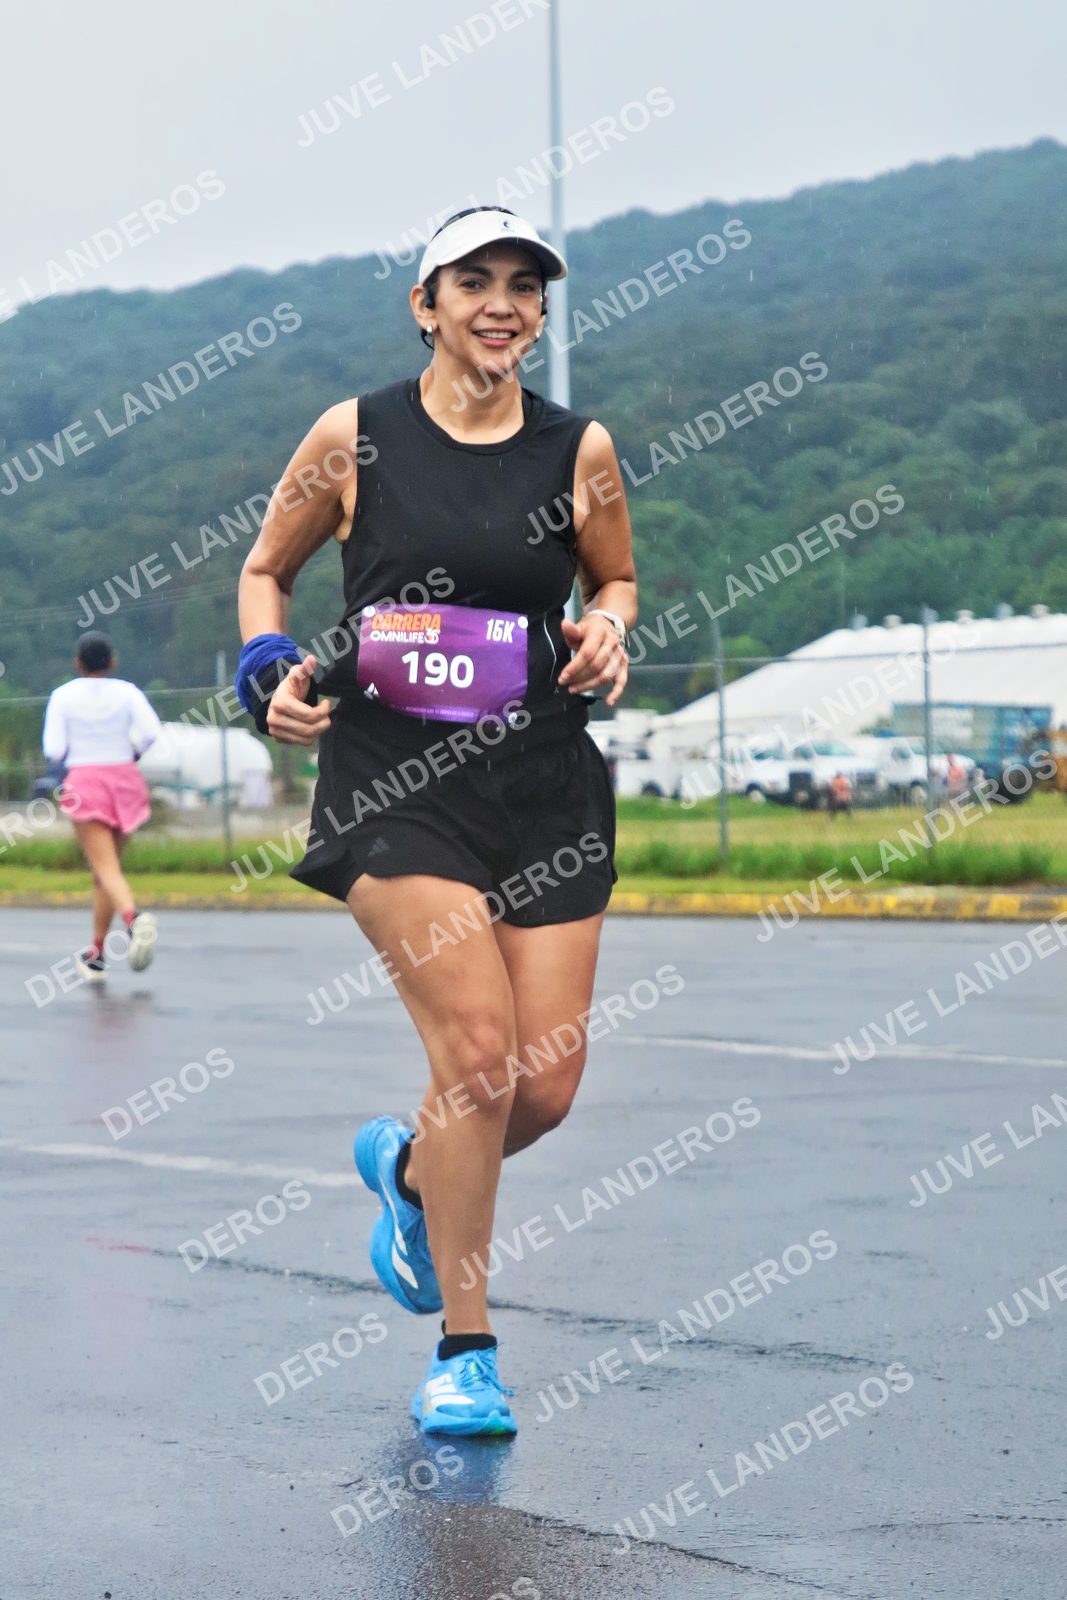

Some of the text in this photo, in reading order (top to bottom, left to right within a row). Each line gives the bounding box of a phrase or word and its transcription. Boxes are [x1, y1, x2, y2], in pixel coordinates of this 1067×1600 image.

[371, 612, 442, 632] CARRERA
[370, 630, 424, 643] OMNILIFE
[402, 651, 474, 688] 190
